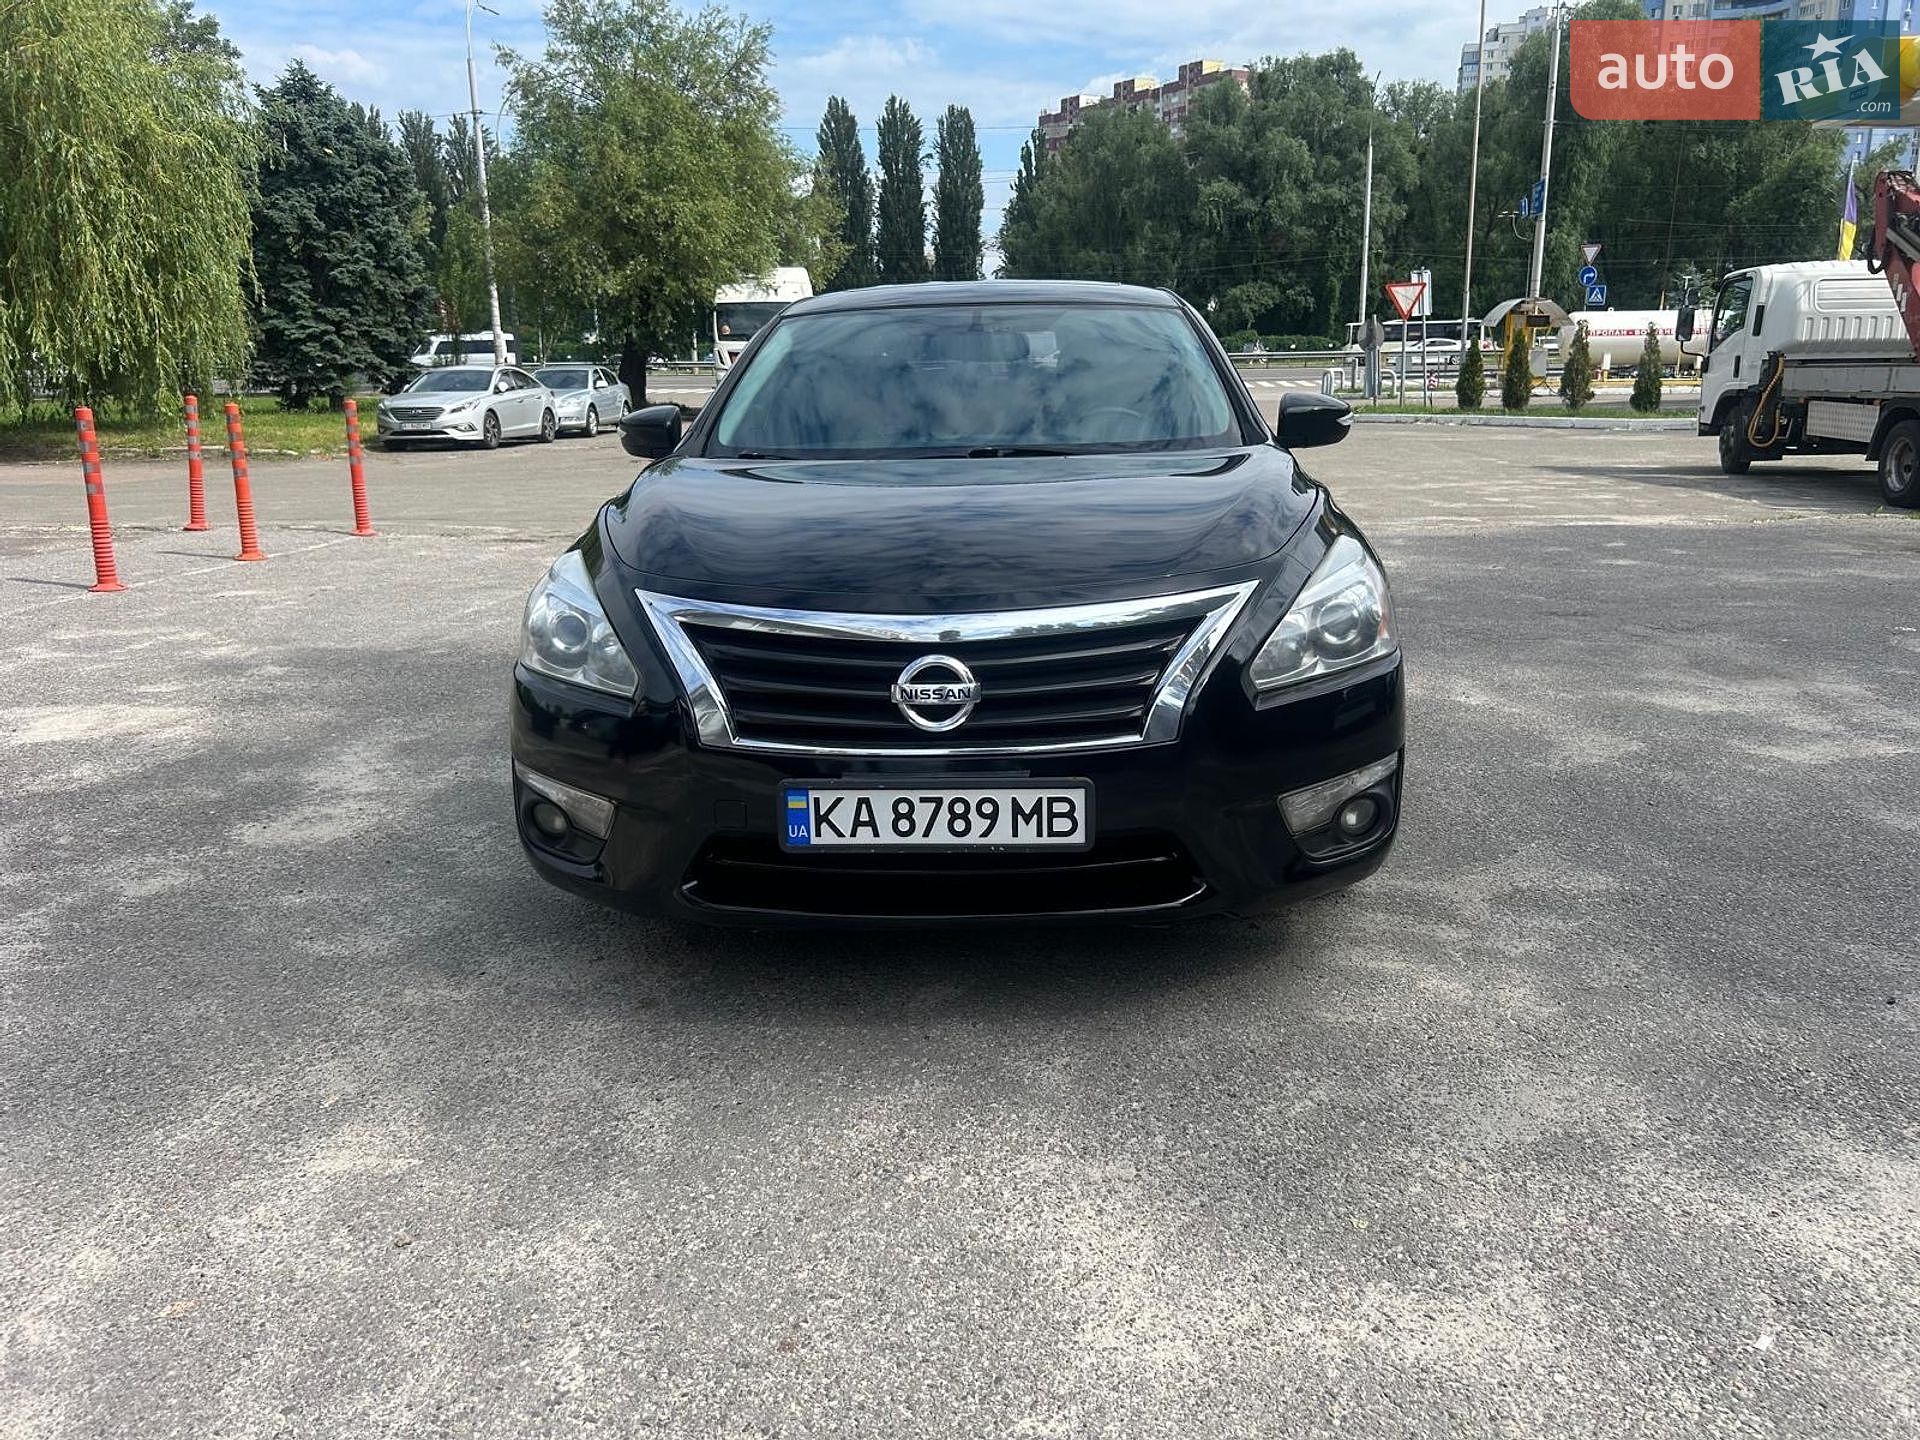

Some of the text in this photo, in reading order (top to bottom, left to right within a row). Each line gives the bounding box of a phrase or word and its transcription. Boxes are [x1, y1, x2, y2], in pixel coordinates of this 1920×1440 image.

[899, 687, 971, 700] NISSAN
[813, 796, 1079, 838] KA 8789 MB
[788, 825, 808, 838] UA
